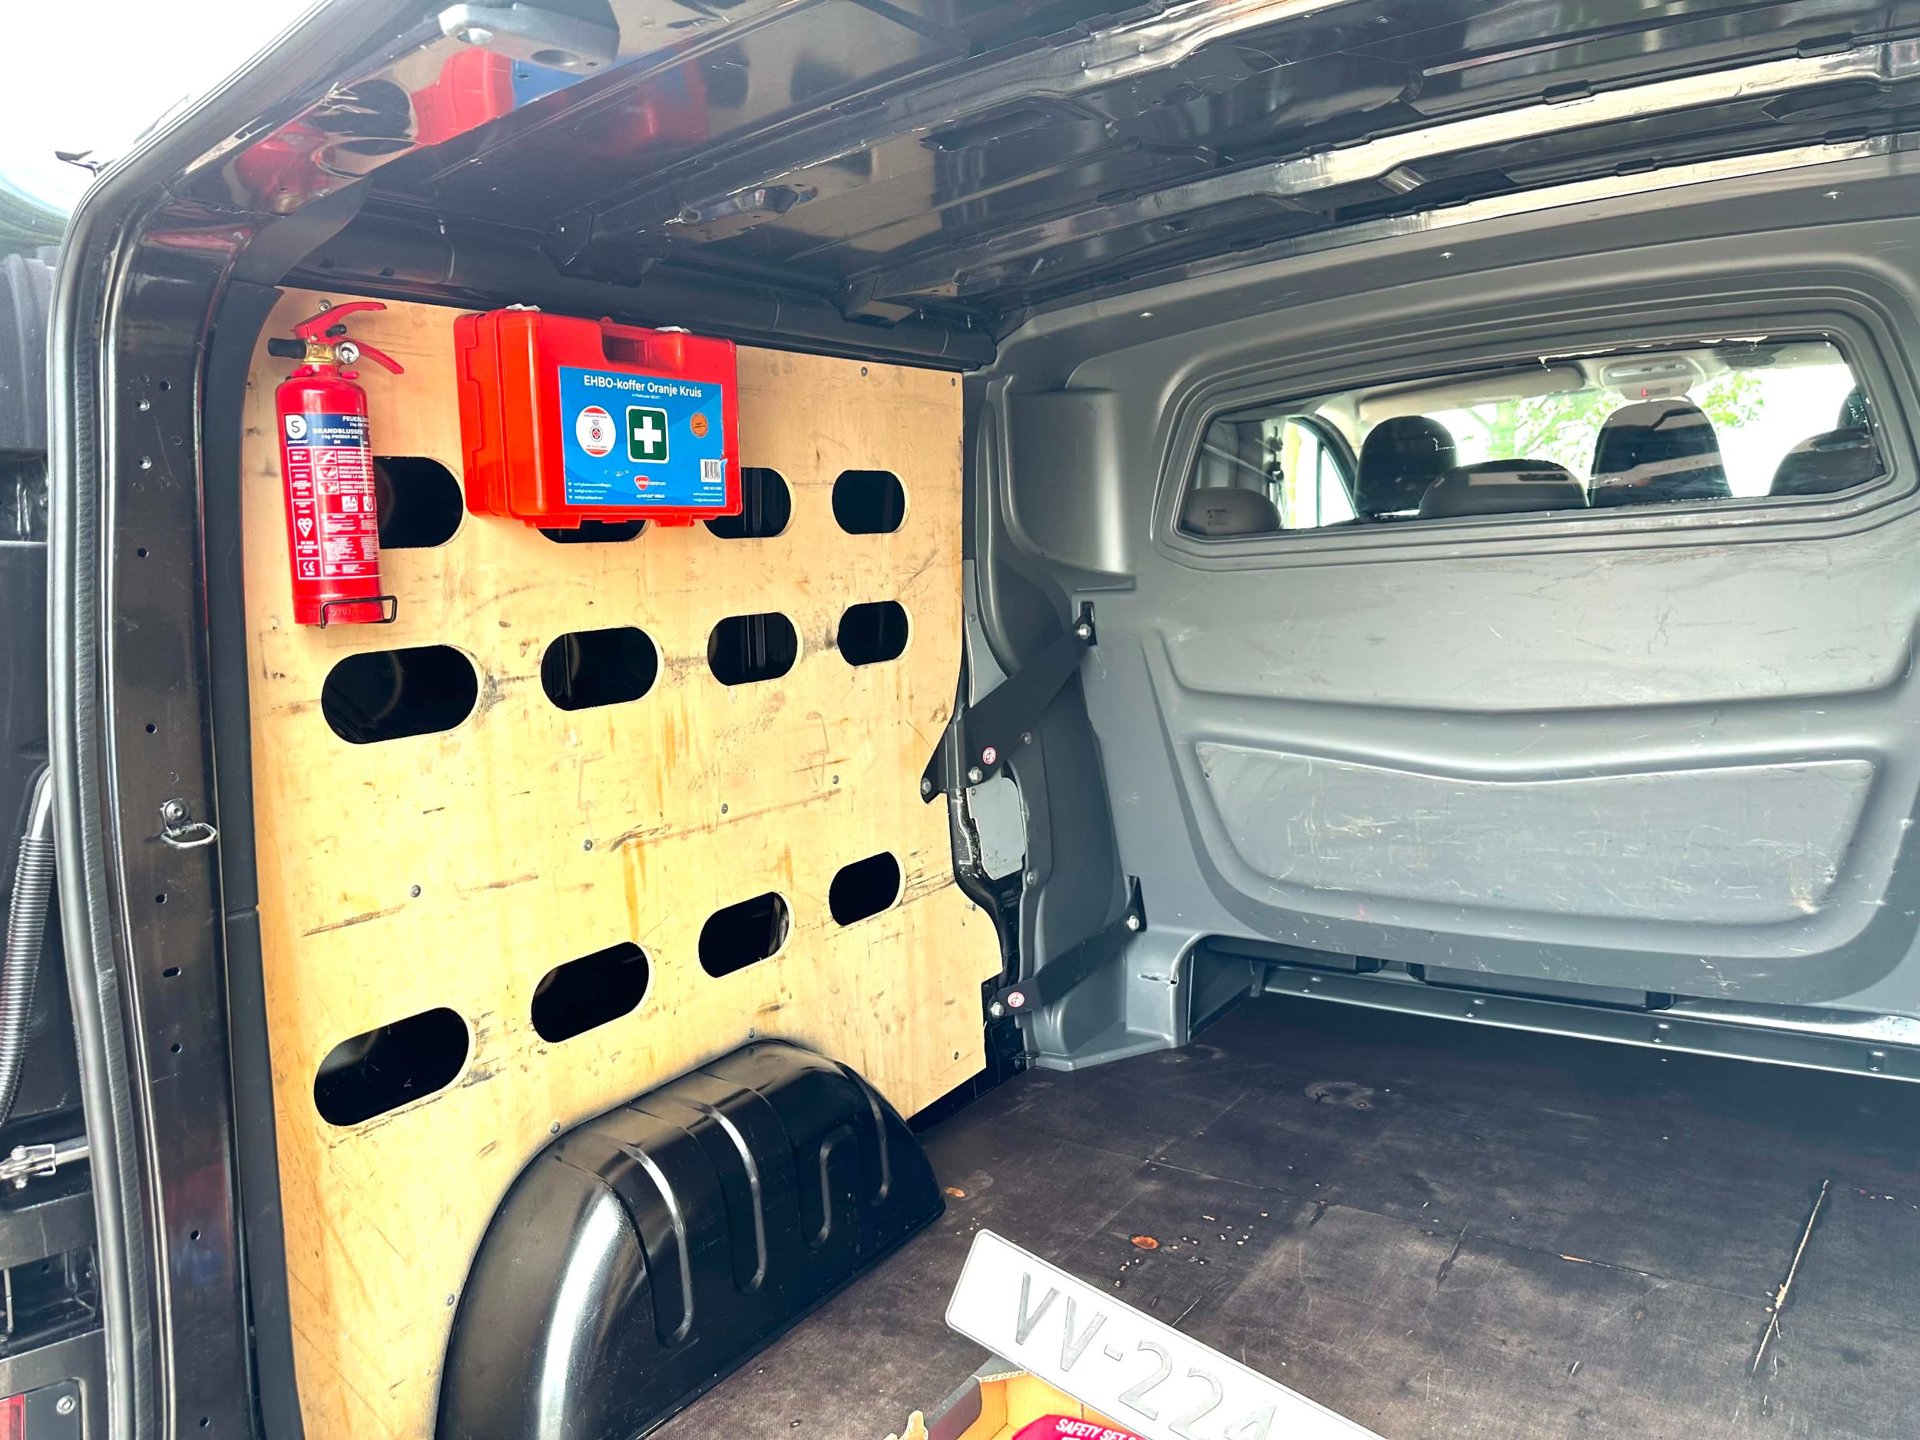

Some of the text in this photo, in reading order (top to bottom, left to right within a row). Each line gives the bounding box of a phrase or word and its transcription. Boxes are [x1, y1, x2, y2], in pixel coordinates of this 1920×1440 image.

[583, 374, 702, 398] EHBO-koffer Oranje Kruis
[1055, 1418, 1103, 1439] SAFETY
